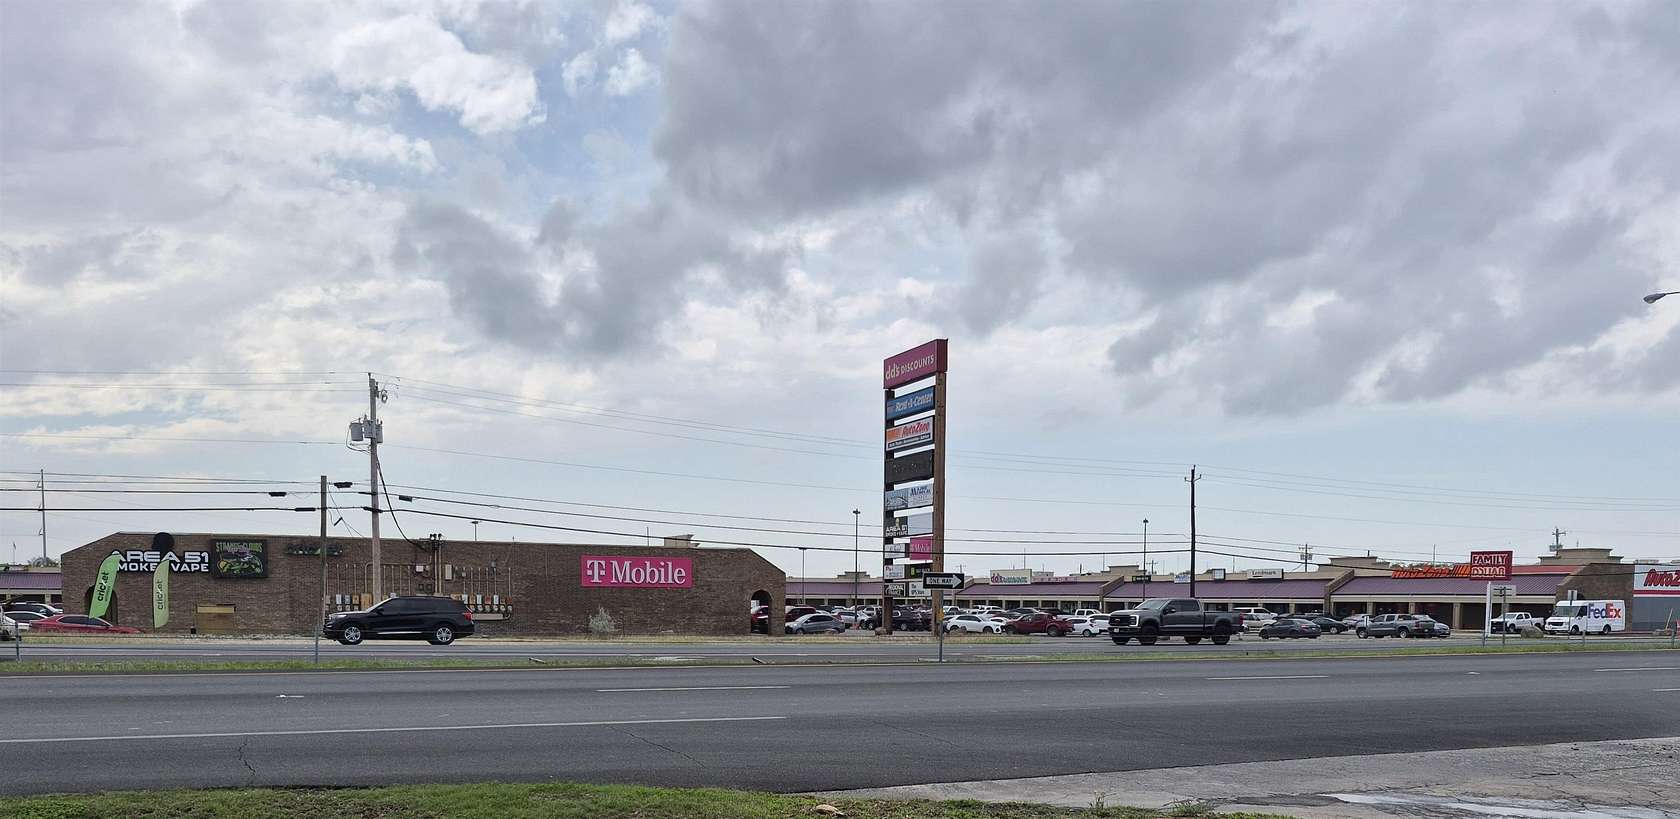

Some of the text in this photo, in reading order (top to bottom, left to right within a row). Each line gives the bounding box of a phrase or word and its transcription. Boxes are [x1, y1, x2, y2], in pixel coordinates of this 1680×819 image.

[900, 354, 935, 375] DISCOUNTS
[184, 551, 209, 562] 51
[1472, 553, 1508, 565] FAMILY
[170, 563, 209, 572] VAPE
[610, 560, 686, 585] Mobile
[97, 571, 110, 602] cricket
[929, 577, 953, 585] ONE WAY
[1588, 602, 1622, 619] FedEx
